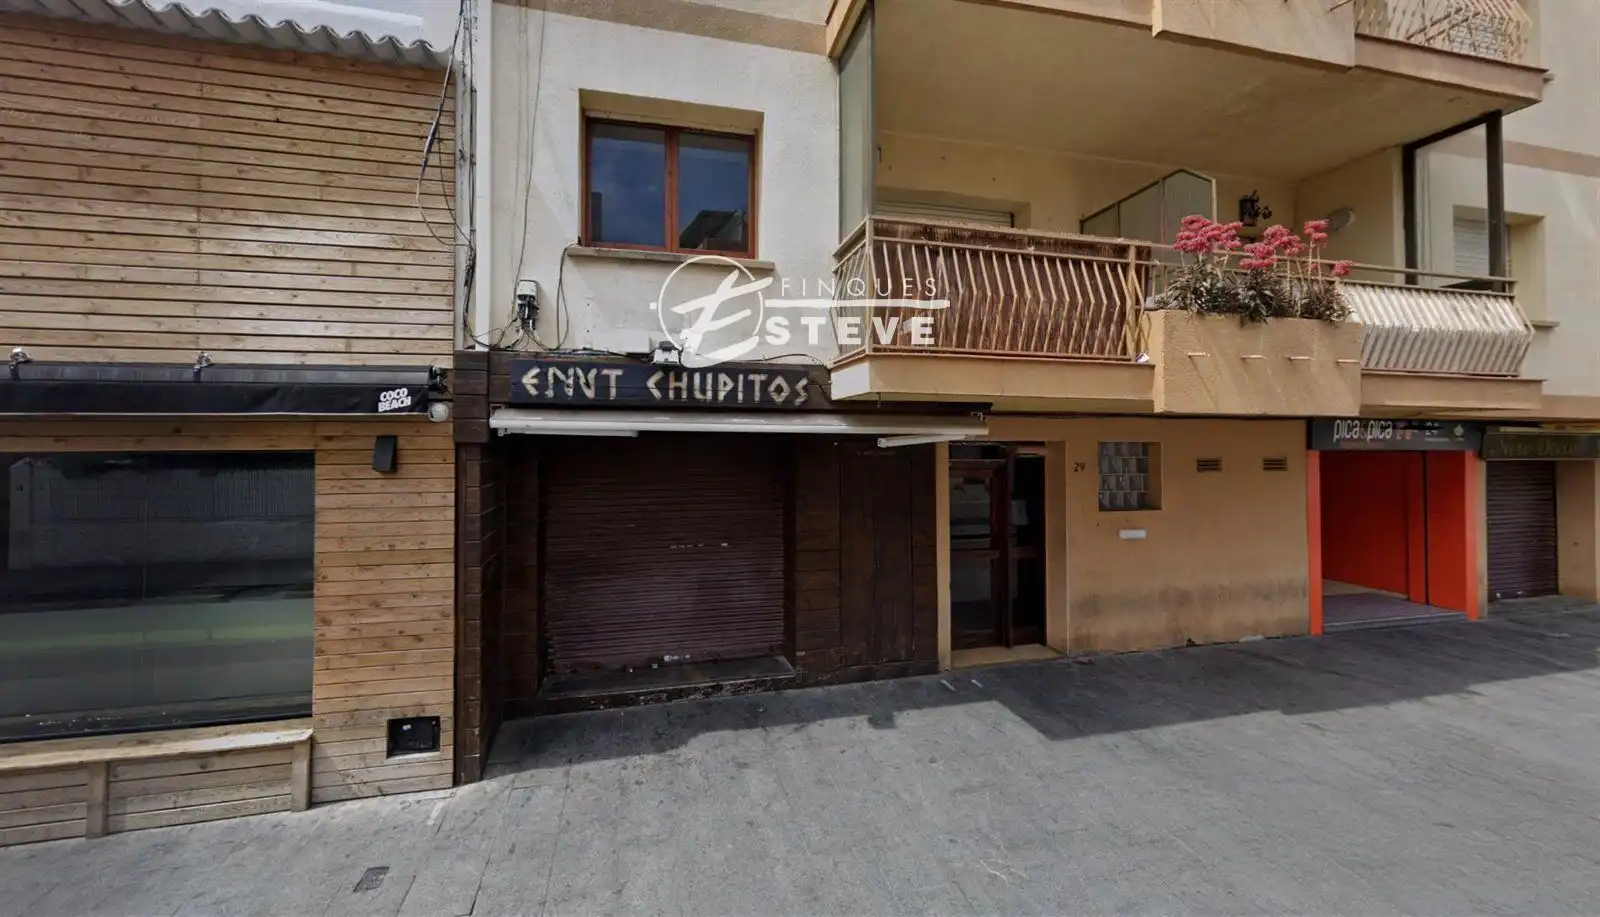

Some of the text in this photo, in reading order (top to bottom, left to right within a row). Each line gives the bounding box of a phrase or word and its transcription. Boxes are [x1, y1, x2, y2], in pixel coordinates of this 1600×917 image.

[379, 387, 408, 402] COCO
[646, 369, 809, 406] CHUPITOS
[377, 395, 412, 412] BEACH
